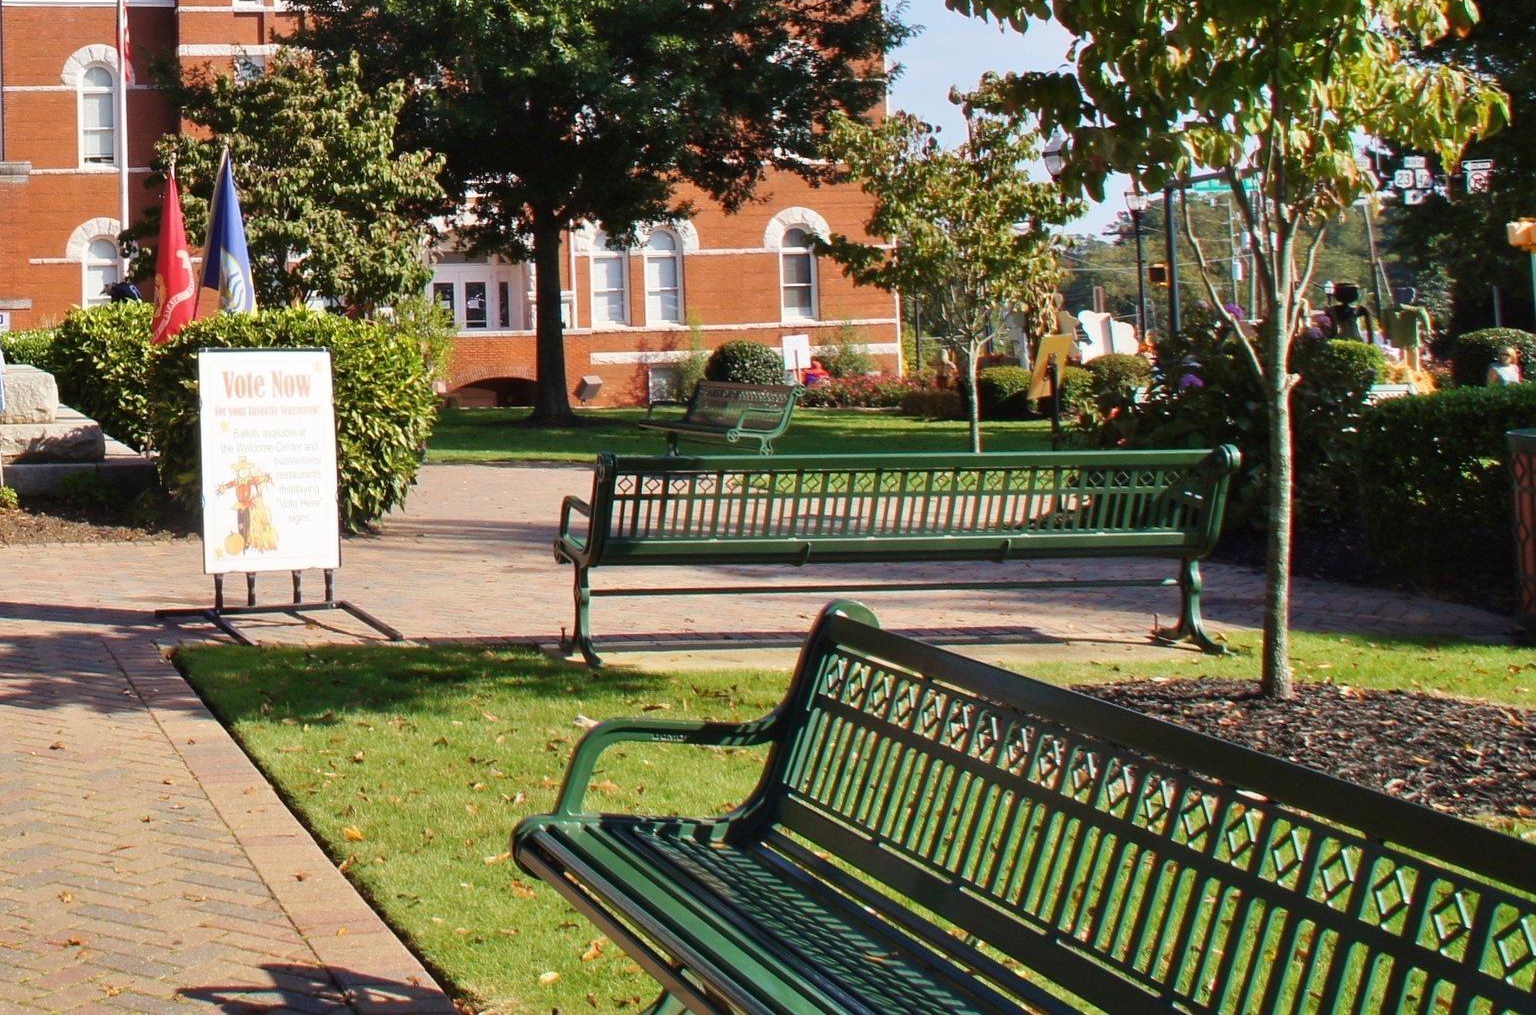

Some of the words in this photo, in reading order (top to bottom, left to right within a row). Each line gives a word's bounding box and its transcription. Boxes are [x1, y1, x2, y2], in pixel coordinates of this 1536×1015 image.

[1405, 157, 1424, 166] NORTH
[1397, 173, 1410, 185] 23
[1418, 174, 1430, 186] 42
[222, 371, 266, 399] Vote
[271, 370, 311, 398] Now
[215, 406, 226, 417] for
[228, 406, 246, 417] your
[249, 405, 278, 416] favorite
[280, 404, 322, 416] Scarecrow!
[233, 428, 260, 439] Ballots
[262, 427, 297, 438] available
[298, 428, 307, 437] at
[221, 443, 234, 453] the
[235, 442, 273, 453] Welcome
[275, 441, 302, 452] Center
[304, 441, 319, 451] and
[274, 455, 323, 465] businesses/
[276, 470, 322, 480] restaurants
[279, 485, 320, 495] displaying
